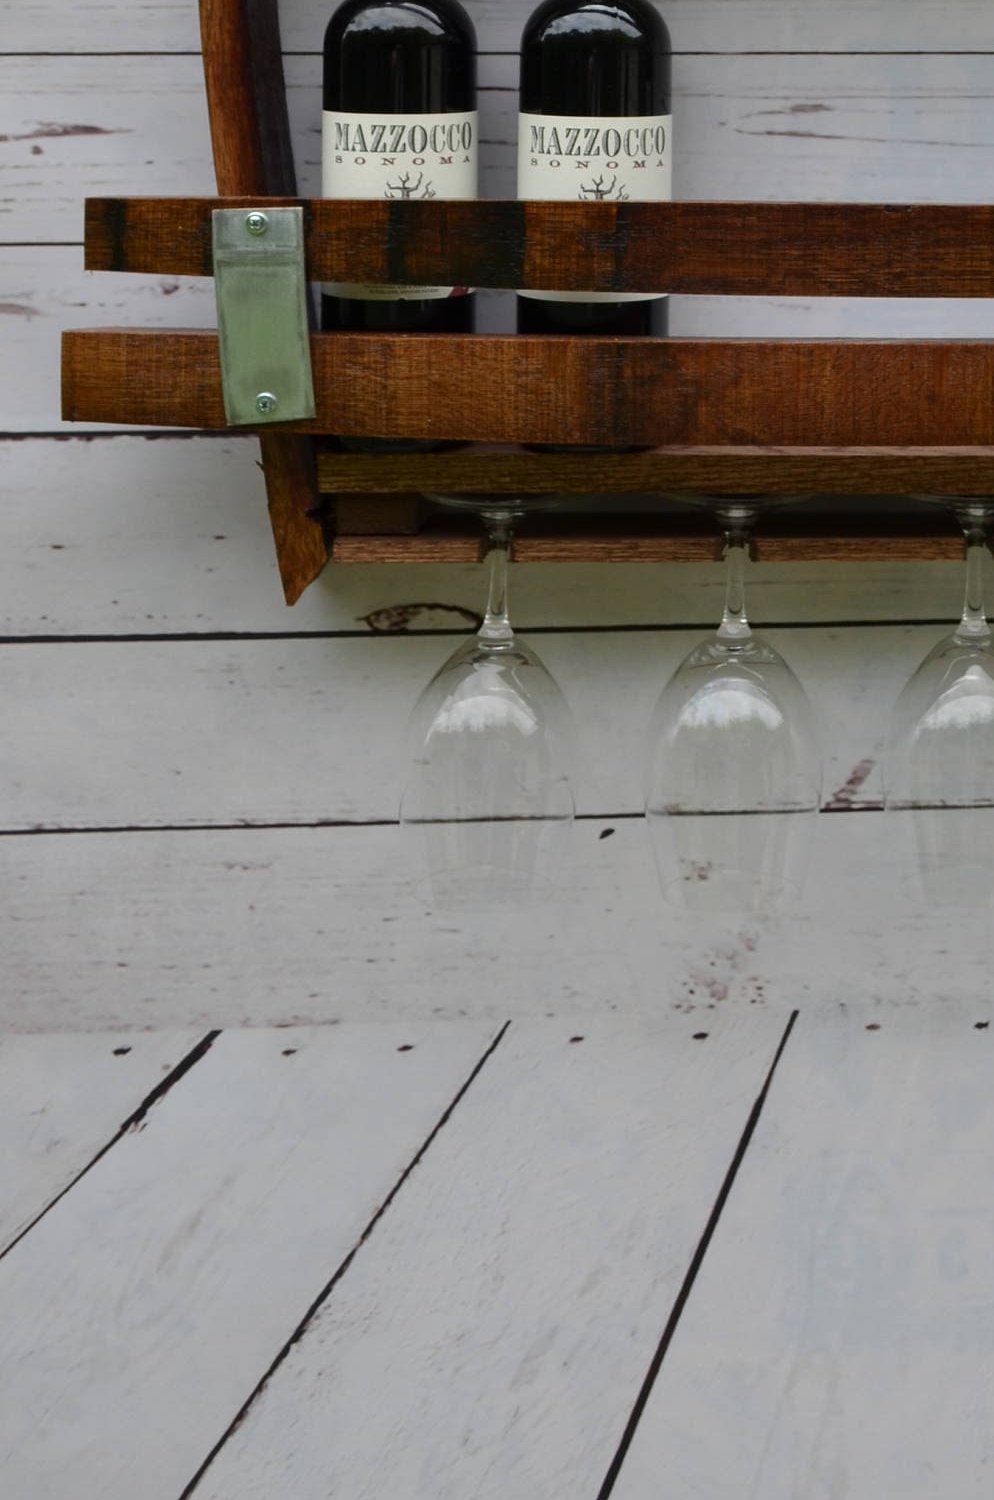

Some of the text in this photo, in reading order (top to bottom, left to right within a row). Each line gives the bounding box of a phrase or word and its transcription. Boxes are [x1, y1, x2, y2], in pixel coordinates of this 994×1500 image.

[334, 121, 472, 154] MAZZOCCO
[530, 125, 666, 157] MAZZOCCO
[335, 155, 471, 166] SONOMA
[530, 158, 664, 169] SONOMA
